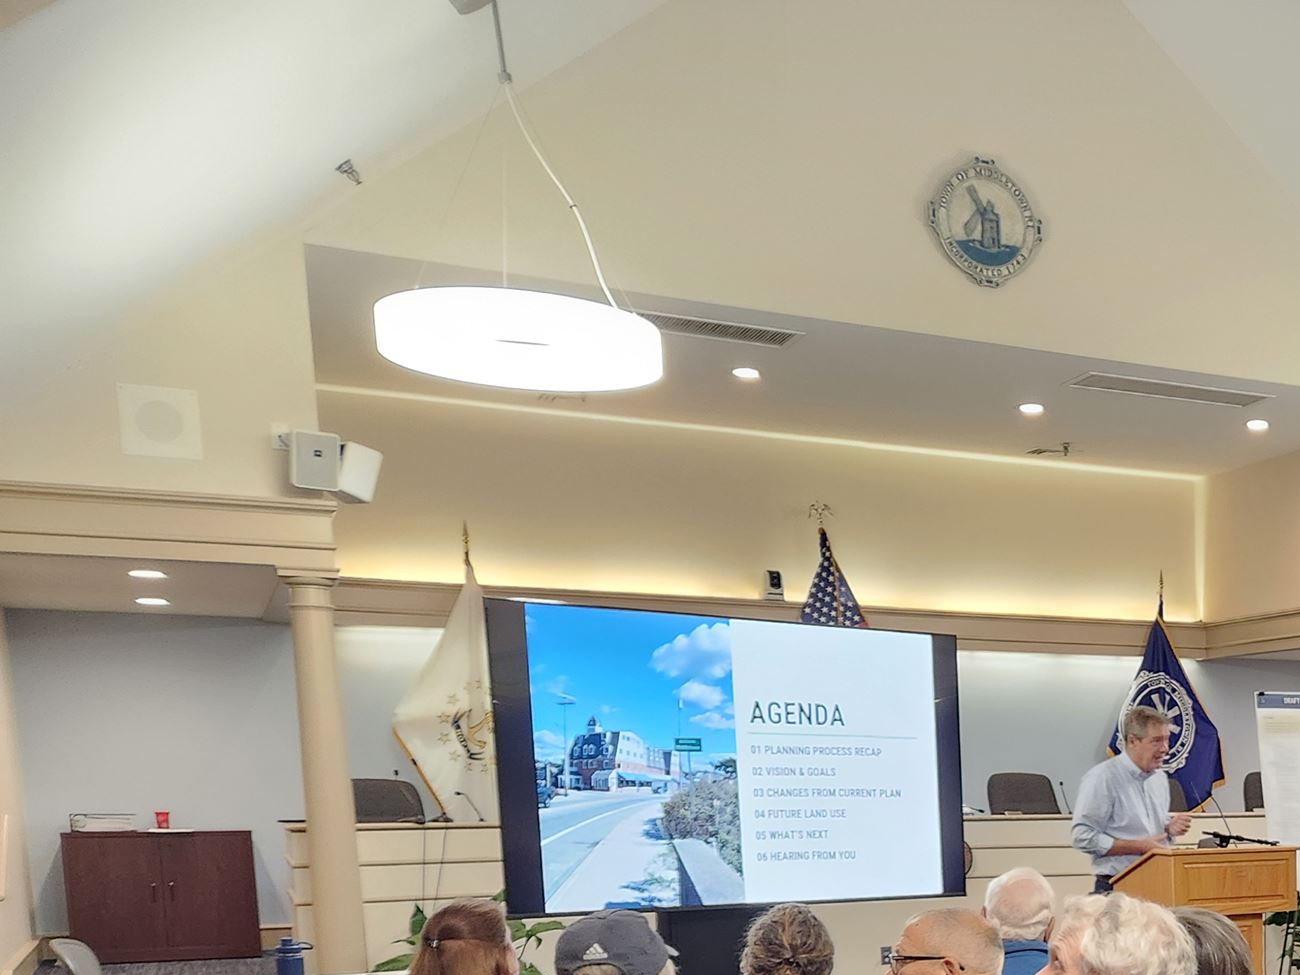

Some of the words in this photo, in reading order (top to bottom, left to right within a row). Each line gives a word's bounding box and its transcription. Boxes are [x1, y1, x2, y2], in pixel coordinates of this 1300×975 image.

[956, 169, 969, 181] OF
[945, 236, 1002, 276] INCORPORATED
[750, 700, 845, 726] AGENDA
[751, 745, 761, 754] 01
[765, 745, 810, 755] PLANNING
[813, 746, 852, 756] PROCESS
[854, 747, 882, 756] RECAP
[752, 767, 763, 776] 02
[765, 767, 796, 776] VISION
[807, 767, 836, 776] GOALS
[753, 788, 764, 797] 03
[766, 788, 809, 797] CHANGES
[812, 788, 836, 797] FROM
[838, 788, 877, 797] CURRENT
[879, 789, 901, 798] PLAN
[755, 810, 765, 818] 04
[768, 809, 802, 818] FUTURE
[804, 809, 828, 818] LAND
[830, 809, 846, 818] USE
[755, 831, 767, 840] 05
[769, 830, 803, 839] WHAT'S
[806, 830, 828, 839] NEXT
[757, 853, 768, 861] 06
[770, 852, 810, 861] HEARING
[812, 851, 836, 860] FROM
[839, 850, 856, 859] YOU
